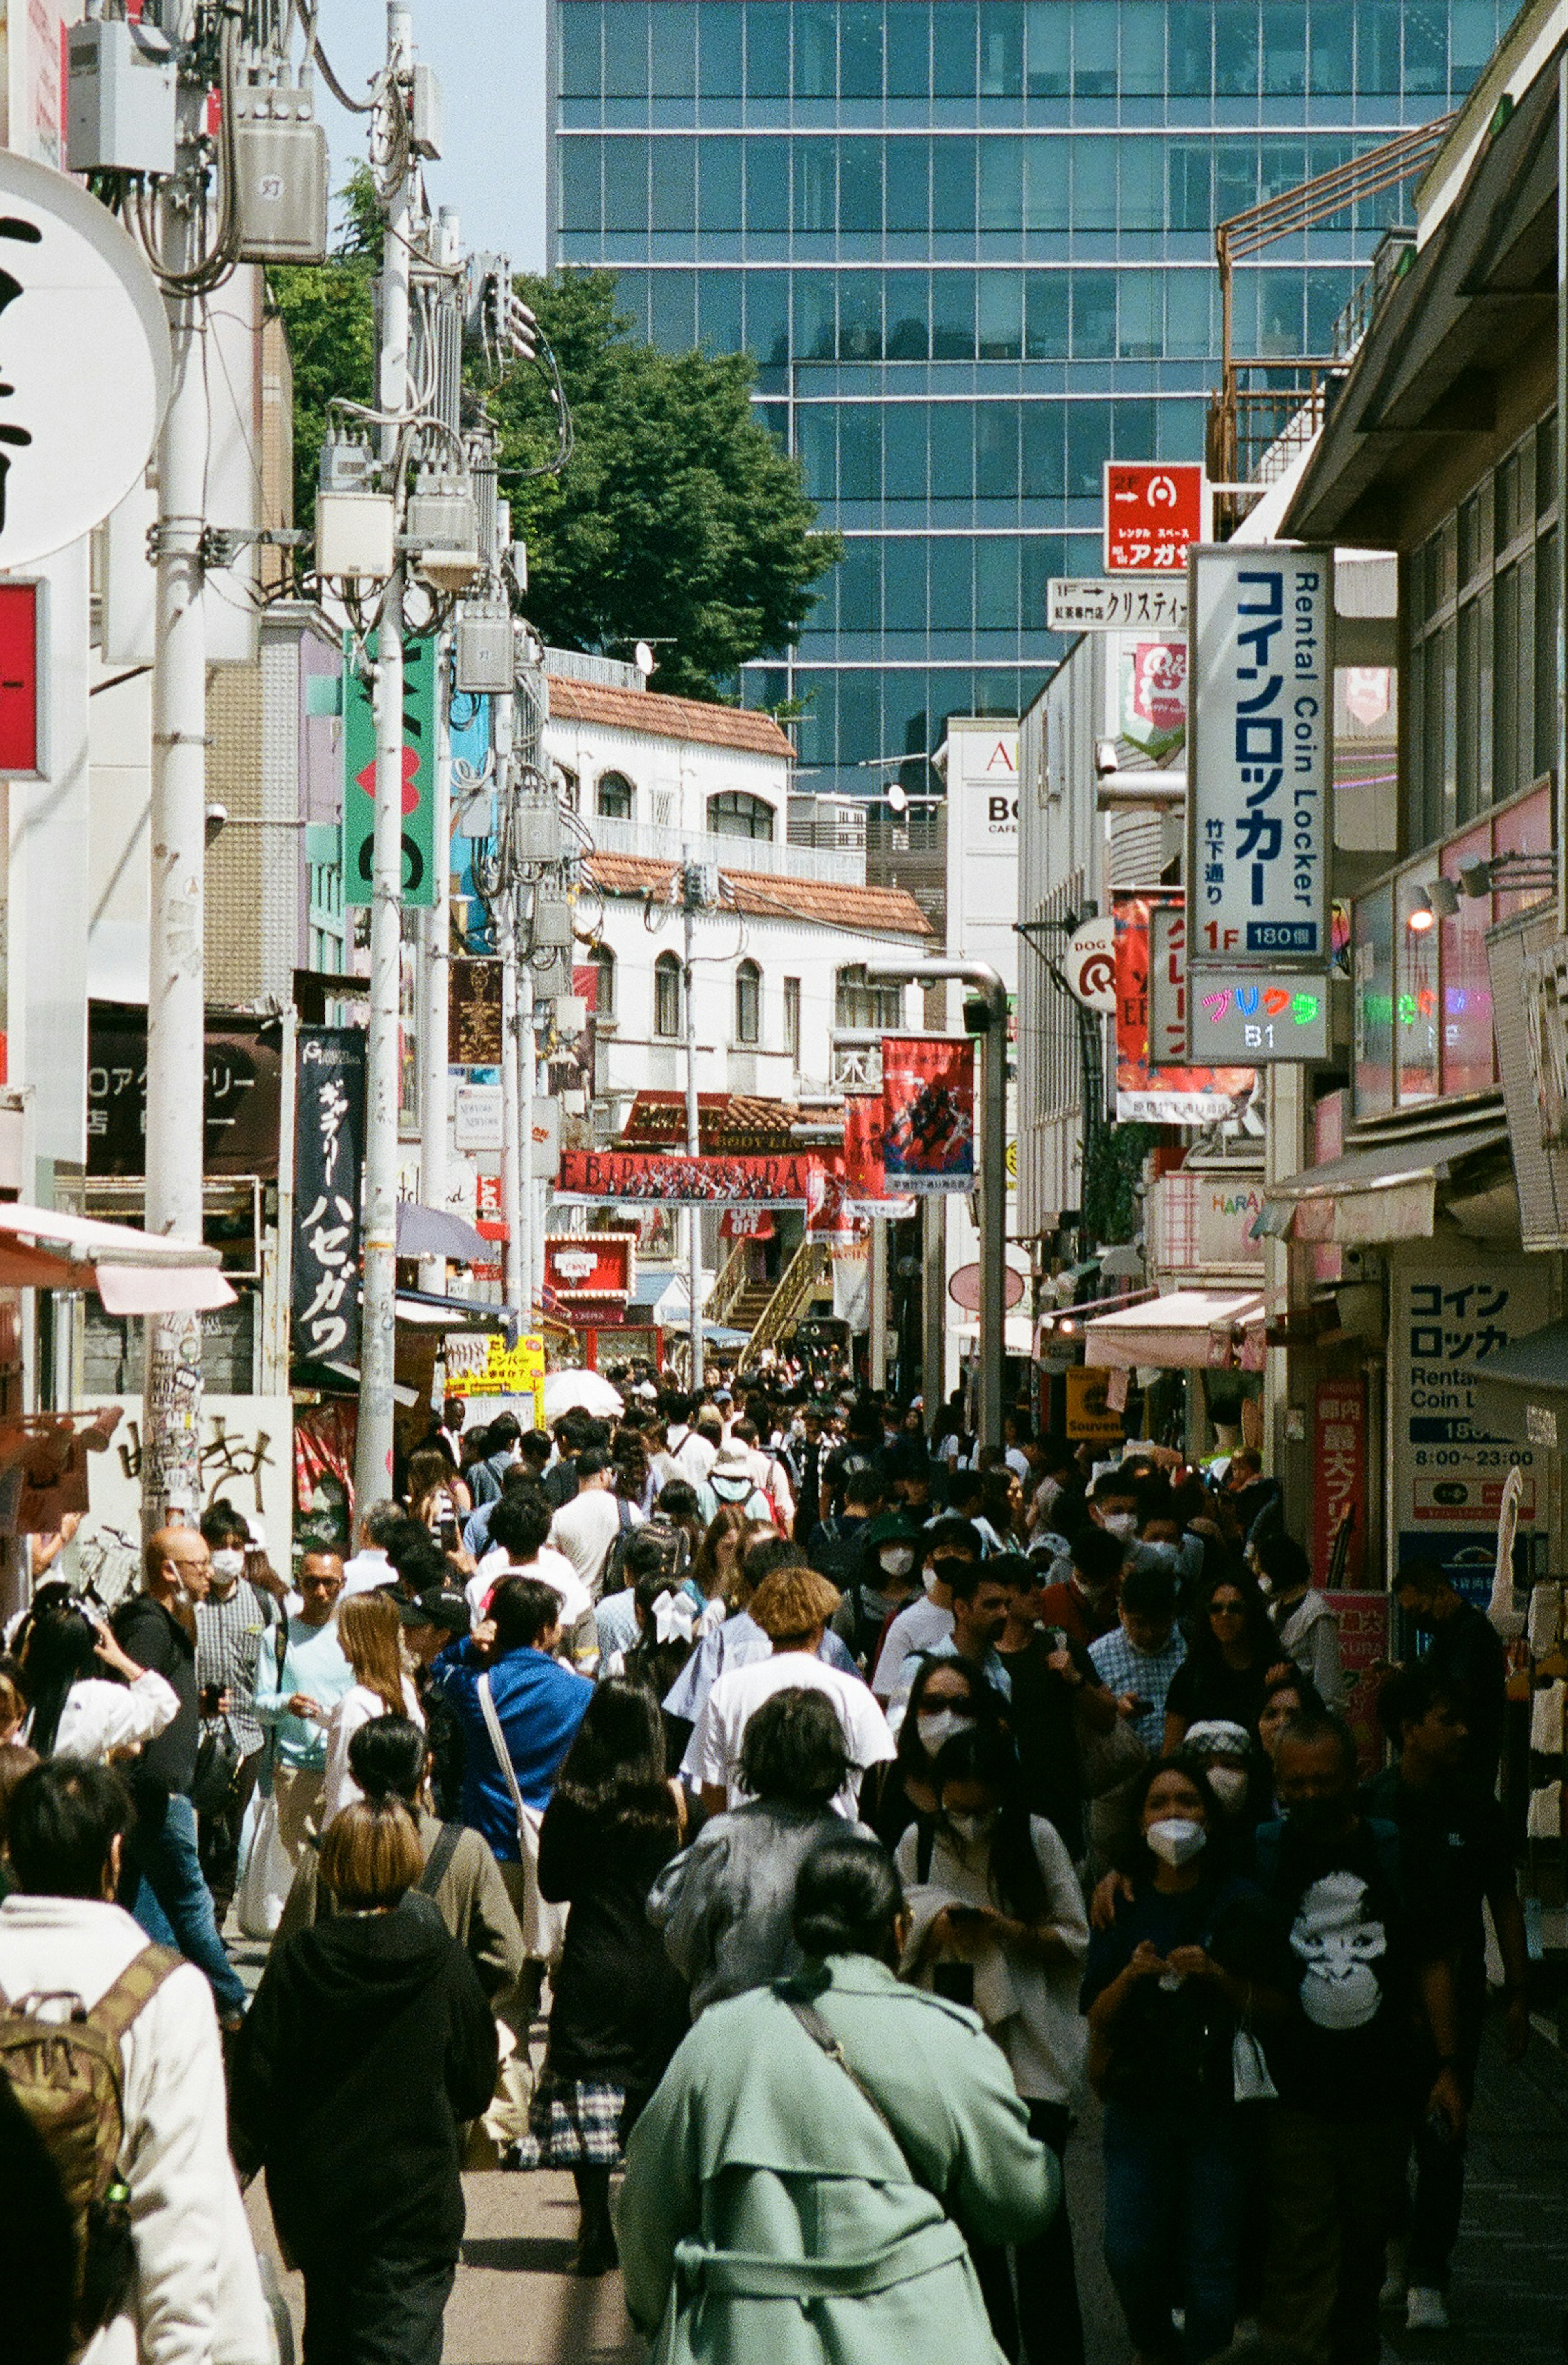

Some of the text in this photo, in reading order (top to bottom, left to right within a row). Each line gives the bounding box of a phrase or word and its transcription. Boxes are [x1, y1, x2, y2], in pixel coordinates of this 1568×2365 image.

[1118, 528, 1190, 539] レンタル スペース
[1235, 571, 1284, 906] コインロッカー
[1293, 572, 1319, 907] Rental Coin Locker
[1204, 818, 1225, 905] 竹下通り
[1074, 940, 1107, 952] DOG
[1204, 921, 1238, 950] 1F
[1254, 926, 1310, 944] 180個
[1245, 1025, 1274, 1048] B1
[731, 1220, 759, 1234] OFF
[299, 1195, 356, 1360] ハセガワ
[1411, 1284, 1509, 1318] コイン
[1411, 1326, 1513, 1359] ロッカ
[1411, 1390, 1459, 1408] Coin
[1069, 1420, 1121, 1432] Souven
